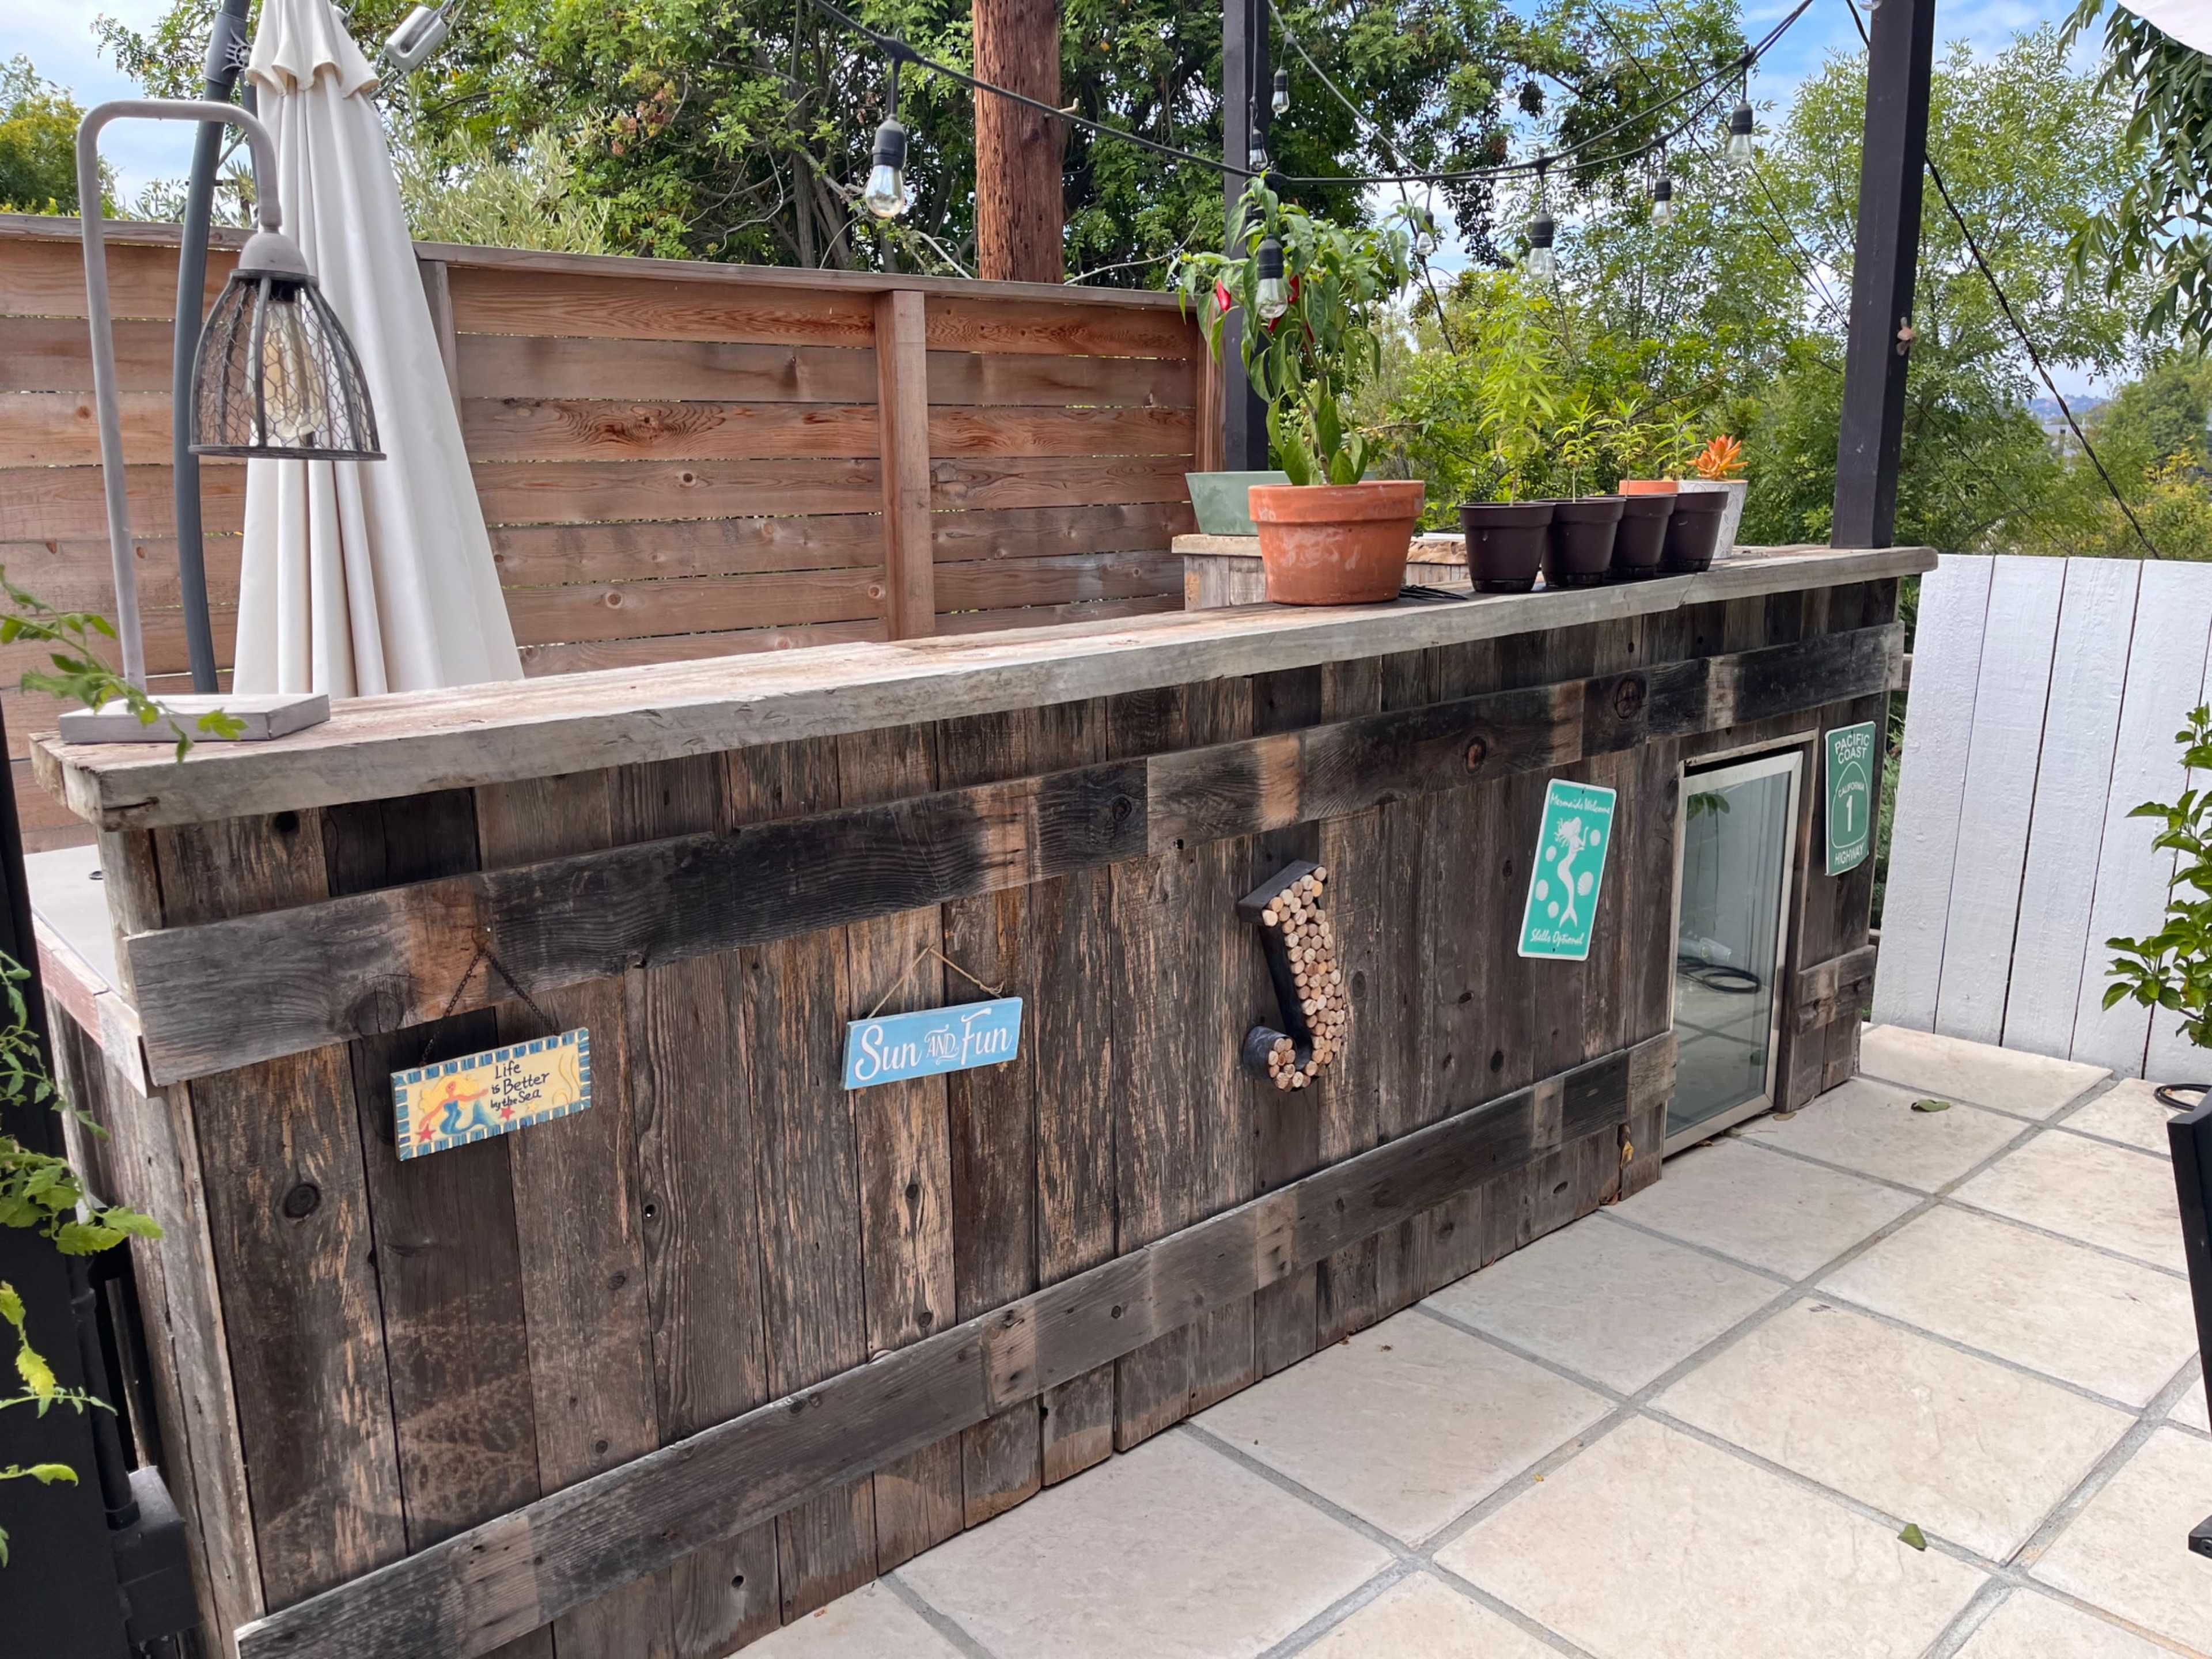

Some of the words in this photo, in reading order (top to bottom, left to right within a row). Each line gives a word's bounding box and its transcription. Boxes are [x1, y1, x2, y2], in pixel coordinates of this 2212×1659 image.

[1834, 733, 1870, 755] PACIFIC
[1838, 747, 1867, 764] COAST
[1838, 782, 1865, 798] CALIFORNIA
[1846, 795, 1853, 832] 1
[1834, 843, 1865, 866] HIGHWAY
[855, 1024, 921, 1081] Sun
[924, 1024, 959, 1065] AND
[960, 1007, 1013, 1065] Fun
[495, 1060, 521, 1079] Life
[491, 1084, 501, 1094] is
[503, 1073, 550, 1095] Better
[490, 1099, 501, 1111] by
[502, 1096, 517, 1107] the
[518, 1089, 542, 1103] Sea
